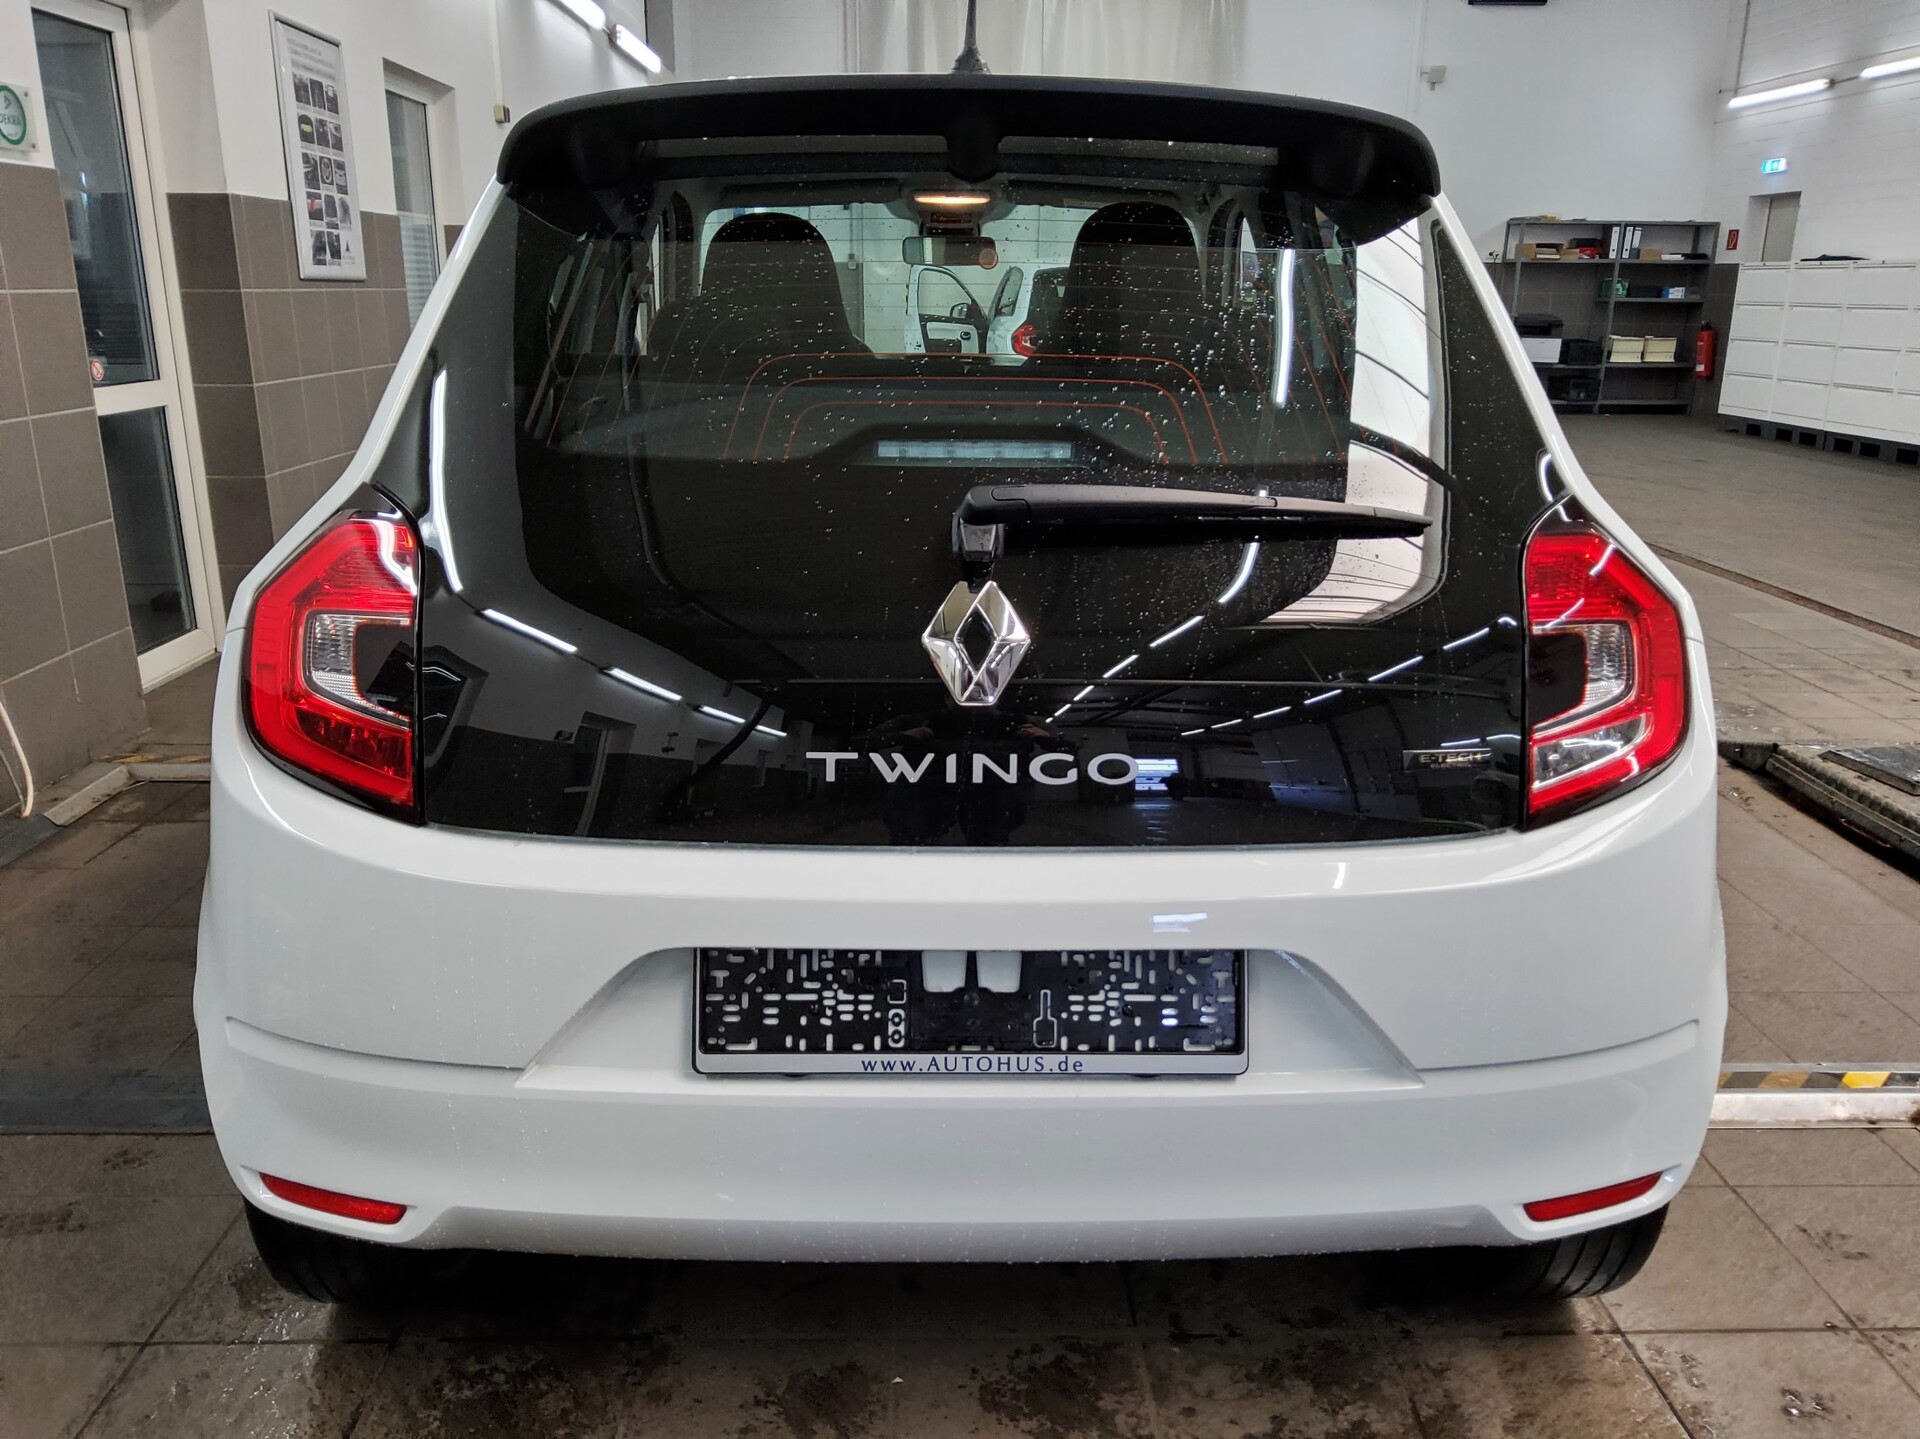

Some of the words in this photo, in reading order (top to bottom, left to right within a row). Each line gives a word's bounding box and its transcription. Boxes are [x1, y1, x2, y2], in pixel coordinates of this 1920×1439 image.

[1419, 752, 1483, 764] E-TECH
[806, 752, 1139, 785] TWINGO
[860, 1055, 1084, 1073] www.AUTOHUS.de
